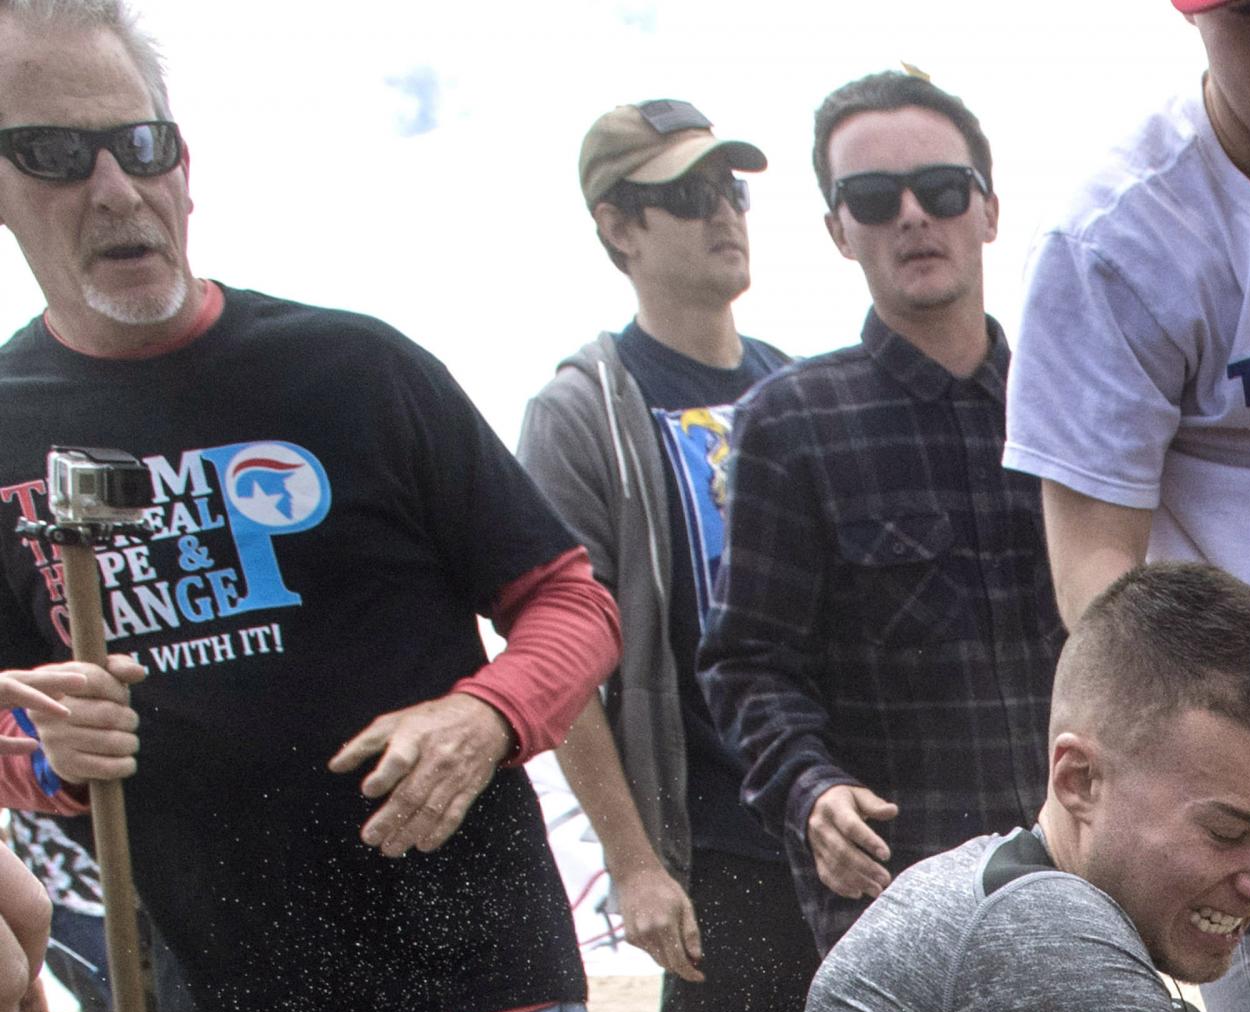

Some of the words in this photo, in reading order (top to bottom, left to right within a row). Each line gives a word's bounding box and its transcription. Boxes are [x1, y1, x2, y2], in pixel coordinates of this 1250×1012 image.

[0, 440, 331, 606] TMP
[40, 545, 157, 602] HPE
[177, 534, 215, 572] &
[51, 568, 243, 648] CANGE
[150, 632, 236, 673] WITH
[239, 623, 285, 655] IT!
